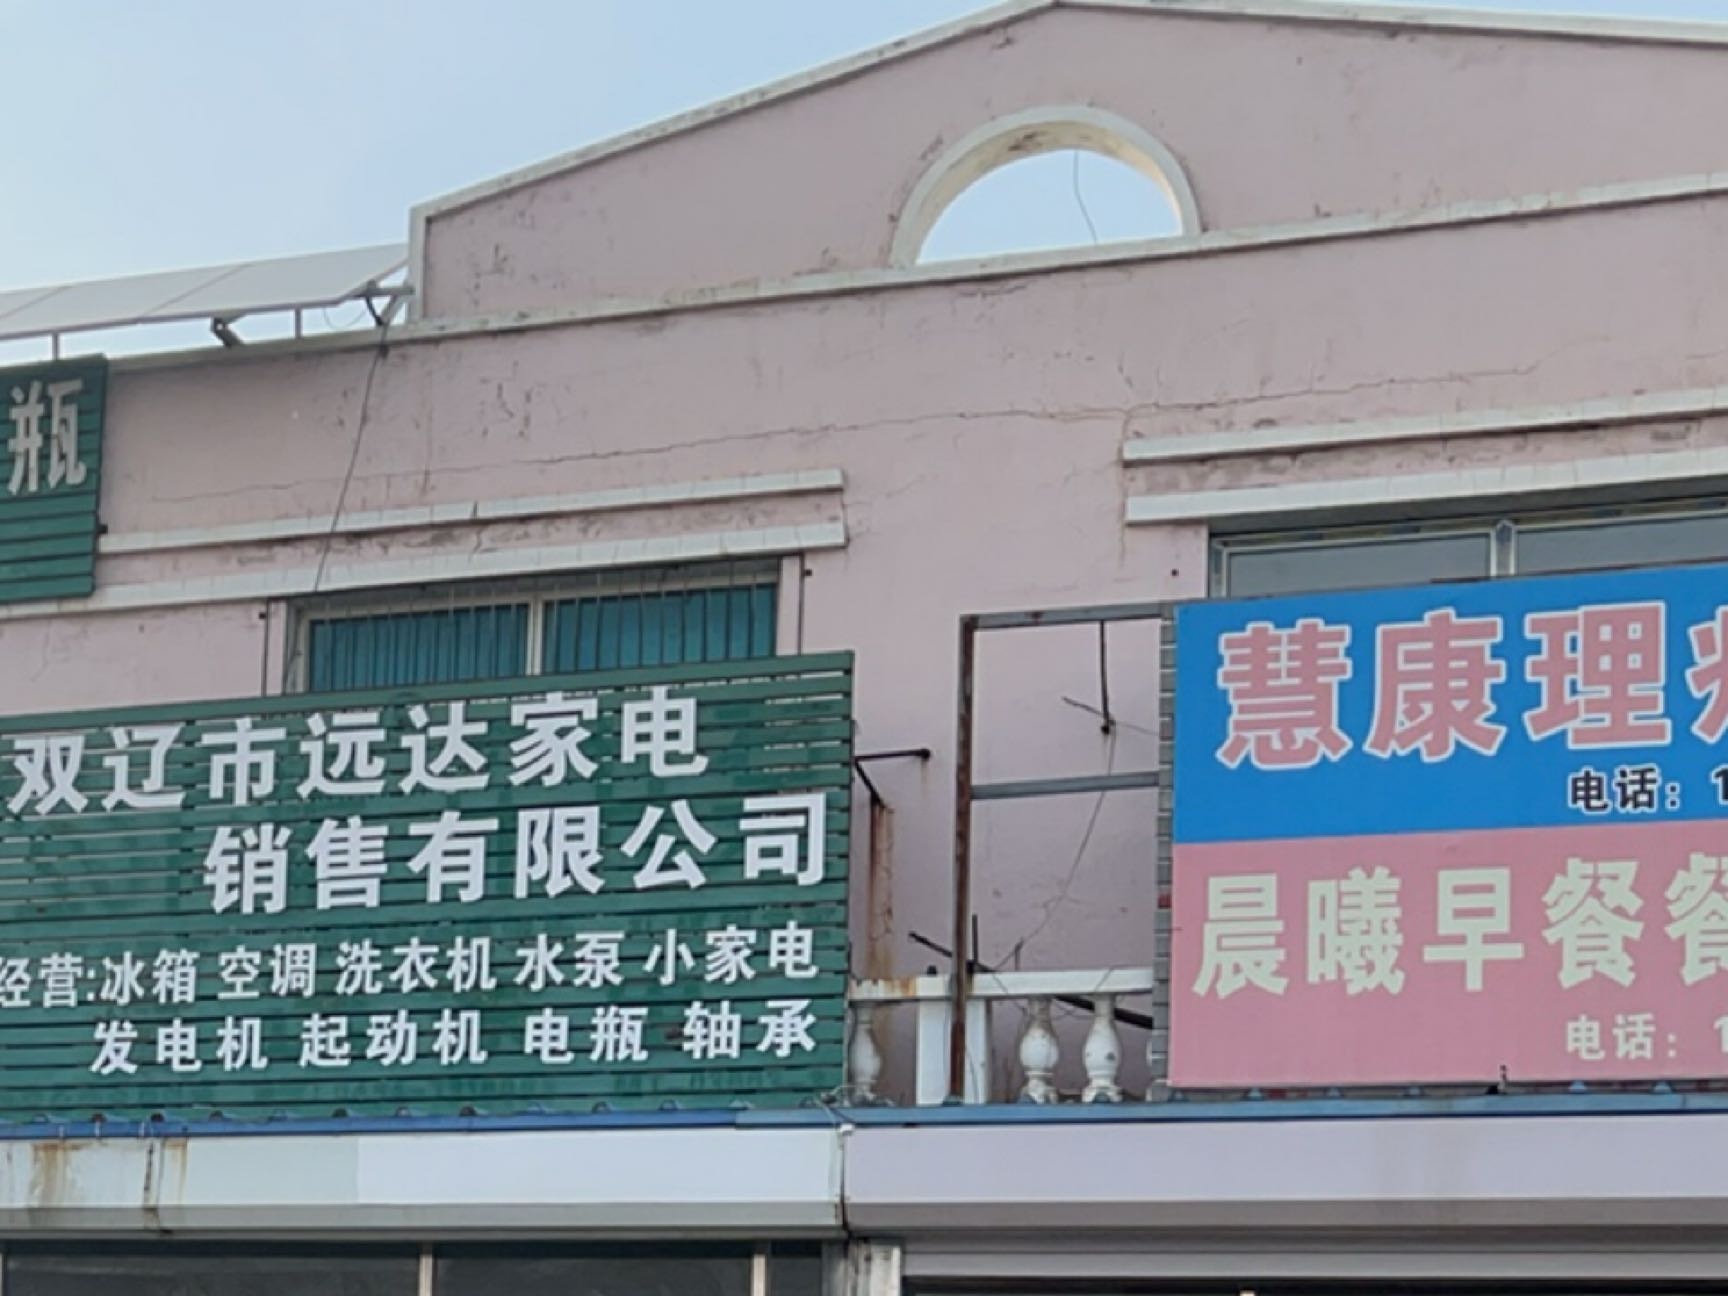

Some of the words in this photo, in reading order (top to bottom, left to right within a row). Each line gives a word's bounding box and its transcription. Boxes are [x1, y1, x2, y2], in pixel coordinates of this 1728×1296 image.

[1216, 600, 1728, 770] 慧康理
[5, 688, 710, 816] 双辽市远达家电
[203, 791, 828, 916] 销售有限公司
[217, 943, 318, 1001] 空调
[334, 935, 498, 995] 洗衣机
[515, 930, 625, 990] 水泵
[643, 919, 820, 984] 小家电
[90, 1015, 269, 1077] 发电机
[298, 1008, 488, 1069] 起动机
[523, 1004, 649, 1065] 电瓶
[681, 998, 818, 1062] 轴承
